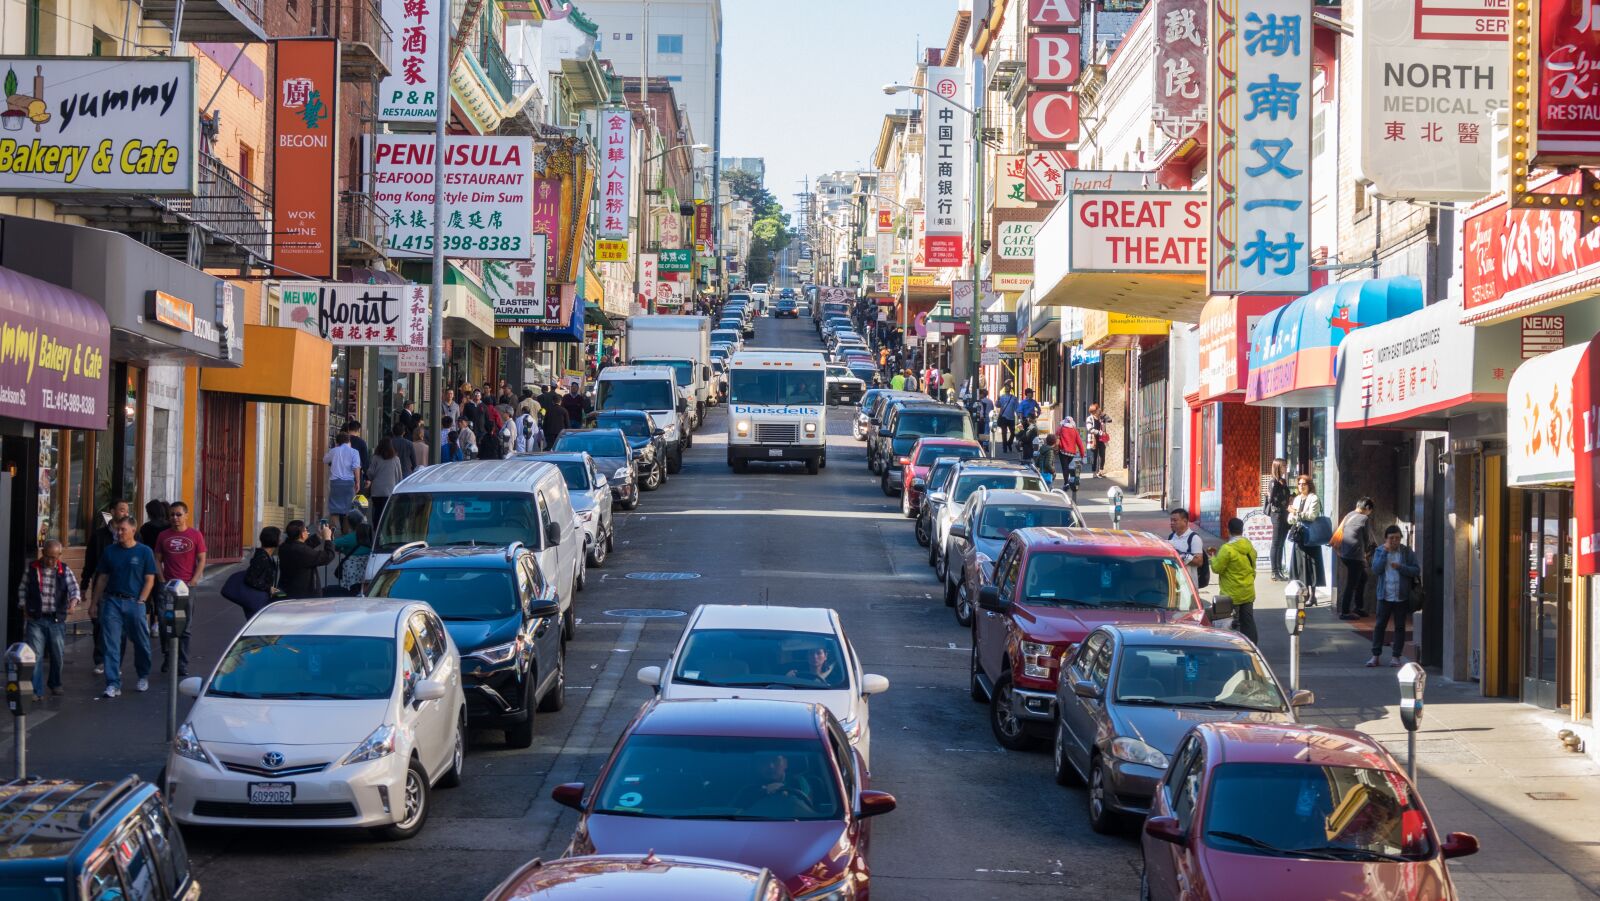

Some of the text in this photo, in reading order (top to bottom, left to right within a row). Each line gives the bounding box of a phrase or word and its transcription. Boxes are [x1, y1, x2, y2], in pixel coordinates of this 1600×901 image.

[1384, 63, 1494, 90] NORTH
[59, 77, 179, 134] yummy
[392, 91, 435, 104] P & R
[1383, 96, 1478, 114] MEDICAL
[280, 135, 327, 147] BEGONI
[1240, 12, 1304, 276] 湖南又一村
[0, 138, 179, 183] Bakery & Cafe
[376, 143, 521, 166] PENINSULA
[938, 107, 954, 214] 中国工商银行
[443, 173, 524, 185] ESTAURANT
[405, 191, 435, 204] Kong
[472, 192, 493, 203] Dim
[498, 192, 523, 203] Sum
[288, 211, 315, 219] WOK
[1080, 200, 1172, 228] GREAT
[1106, 237, 1207, 264] THEATE
[283, 291, 318, 306] MEI WO
[500, 298, 539, 306] EASTERN
[318, 287, 399, 339] florist
[1523, 317, 1563, 329] NEMS
[39, 334, 72, 382] Bakery
[73, 343, 82, 375] &
[83, 345, 102, 380] Cafe
[1492, 368, 1506, 381] 東
